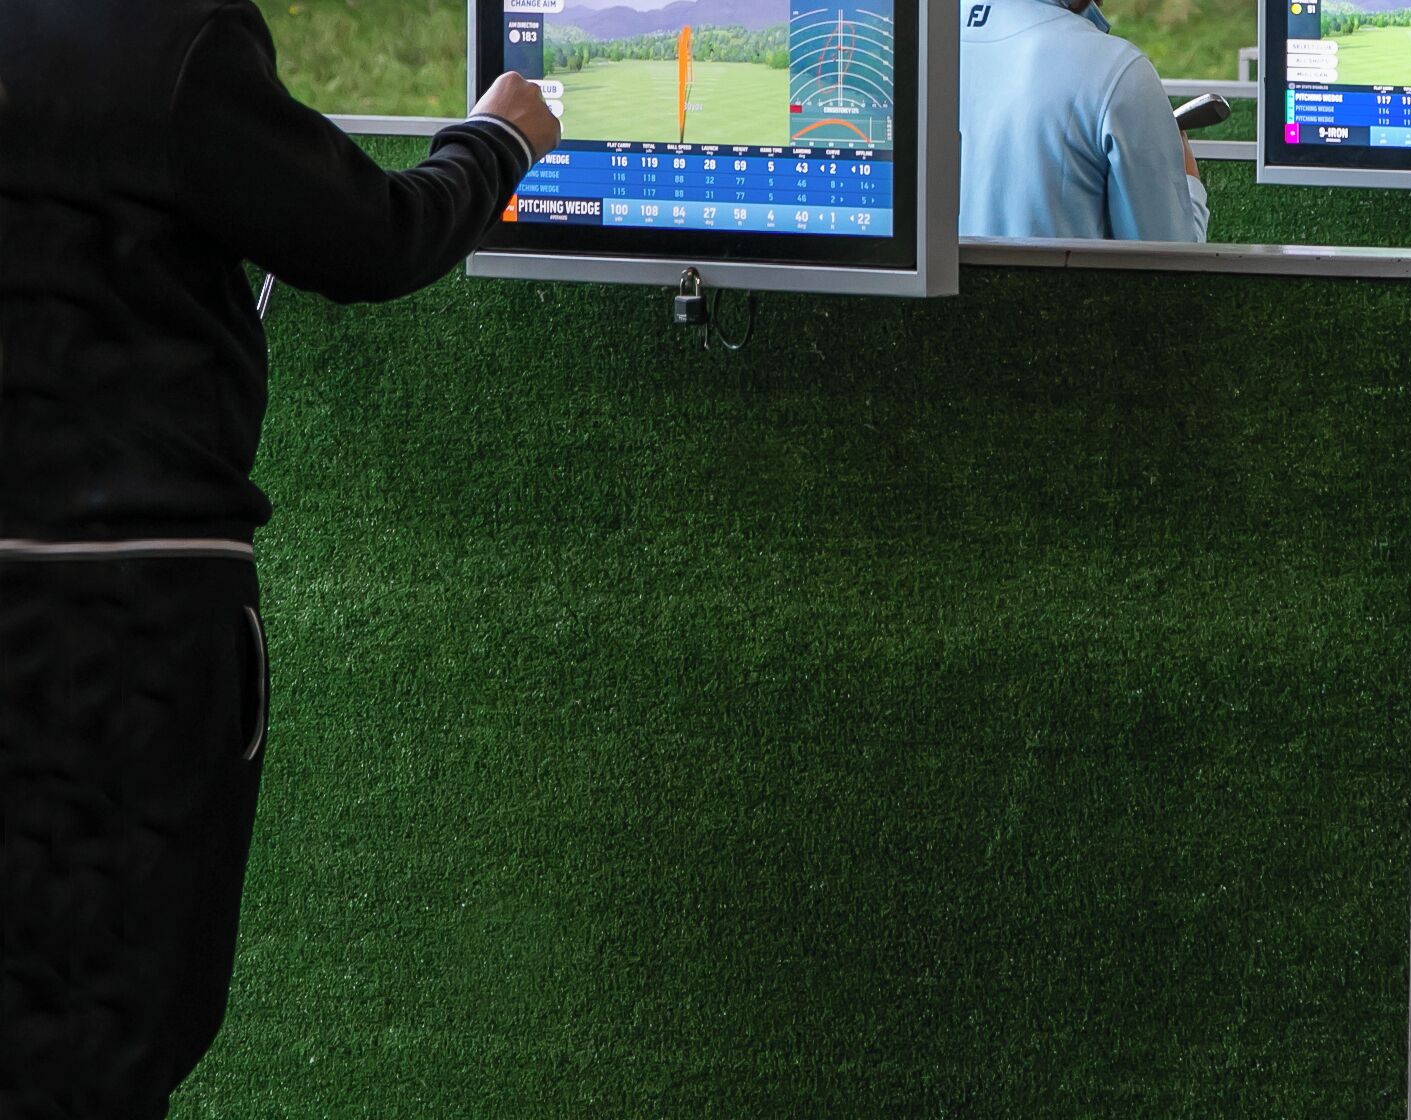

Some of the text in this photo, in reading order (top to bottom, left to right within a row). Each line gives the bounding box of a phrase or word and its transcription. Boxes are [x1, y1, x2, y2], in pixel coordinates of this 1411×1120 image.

[510, 0, 557, 8] CHANGE AIM
[966, 4, 992, 27] FJ
[1318, 126, 1349, 138] 9-IRON
[546, 155, 570, 165] WEDGE
[611, 156, 628, 167] 116
[641, 157, 658, 168] 119
[673, 158, 686, 169] 89
[703, 159, 716, 170] 28
[734, 160, 747, 171] 69
[767, 161, 775, 172] 5
[795, 162, 809, 173] 43
[829, 163, 837, 174] 2
[859, 164, 871, 175] 10
[539, 170, 560, 179] WEDGE
[613, 172, 626, 181] 116
[643, 174, 656, 182] 118
[705, 176, 715, 184] 32
[735, 177, 745, 185] 77
[768, 178, 774, 187] 5
[797, 179, 807, 188] 46
[860, 181, 869, 190] 14
[539, 185, 560, 193] WEDGE
[613, 187, 626, 195] 115
[643, 188, 656, 197] 117
[705, 190, 714, 199] 31
[735, 191, 745, 200] 77
[768, 193, 774, 201] 5
[797, 194, 807, 202] 46
[830, 195, 836, 204] 2
[861, 196, 867, 205] 5
[518, 199, 871, 225] PITCHING WEDGE 100 108 84 27 58 4 40 1 22
